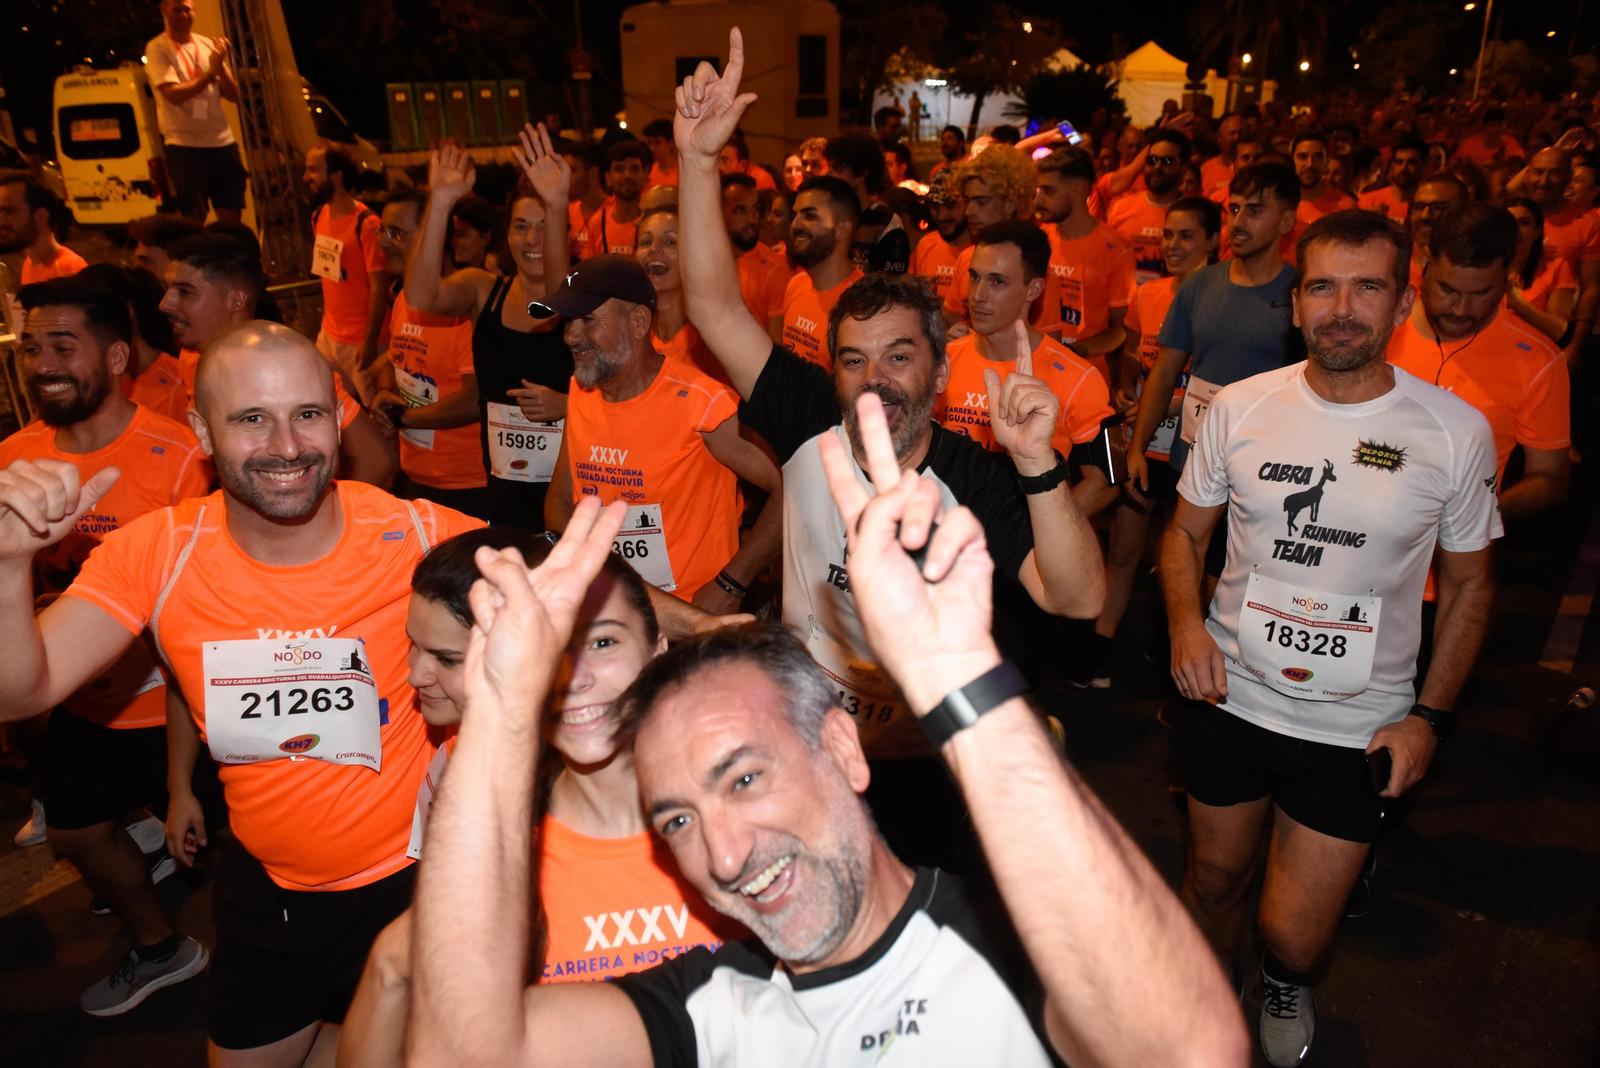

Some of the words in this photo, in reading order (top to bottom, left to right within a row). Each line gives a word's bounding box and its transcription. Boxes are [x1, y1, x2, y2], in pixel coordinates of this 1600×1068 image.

[401, 322, 424, 338] XXXV
[795, 315, 818, 333] XXXV
[963, 392, 989, 409] XX
[945, 406, 977, 416] CARRERA
[949, 414, 991, 427] GUADAL
[589, 445, 629, 466] XXXV
[1360, 447, 1399, 460] DEPORTE
[1363, 456, 1393, 466] MANIA
[576, 461, 602, 472] CARRERA
[605, 466, 643, 477] NOCTURNA
[1258, 462, 1314, 485] CABRA
[580, 470, 644, 487] GUADALQUIVIR
[79, 514, 117, 522] OCTURNA
[1301, 524, 1367, 548] RUNNING
[1272, 539, 1324, 567] TEAM
[1264, 620, 1347, 658] 18328
[240, 686, 354, 719] 21263
[336, 752, 374, 763] Cruzcampo
[583, 903, 689, 952] XXXV
[542, 954, 624, 978] CARRERA
